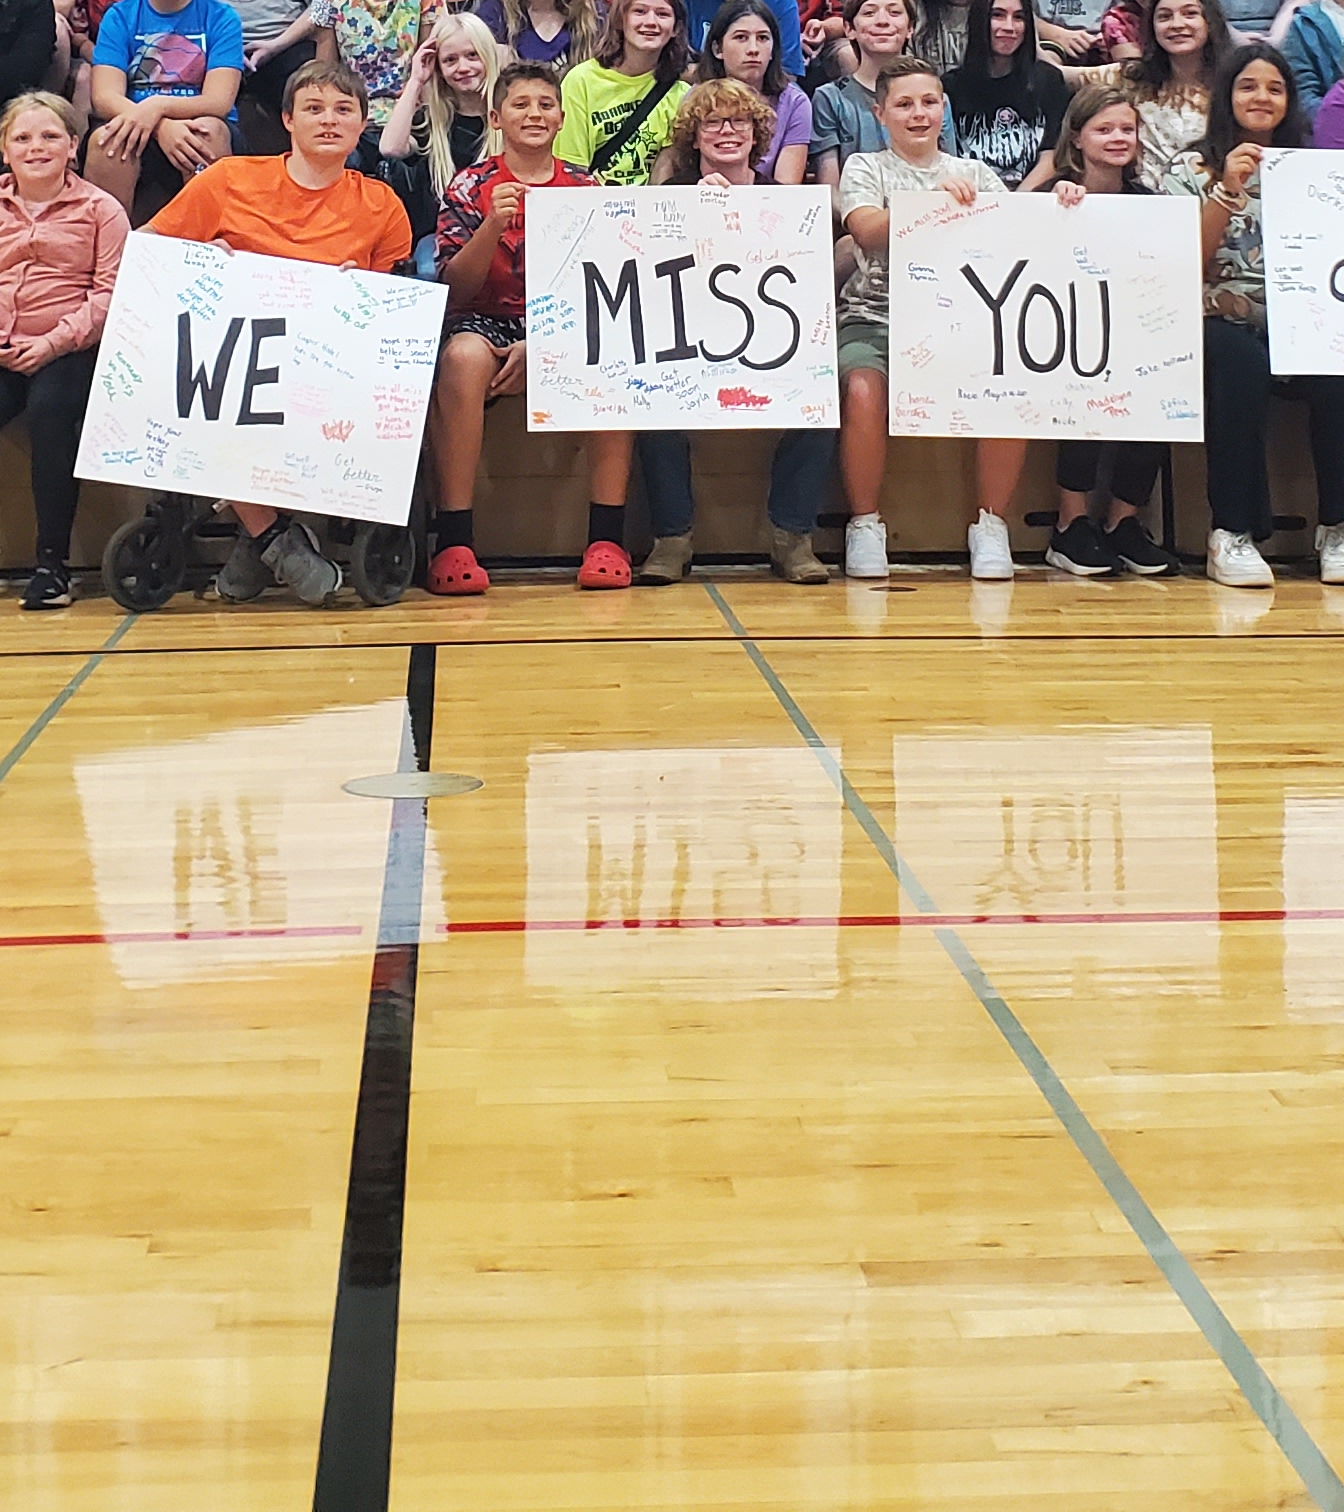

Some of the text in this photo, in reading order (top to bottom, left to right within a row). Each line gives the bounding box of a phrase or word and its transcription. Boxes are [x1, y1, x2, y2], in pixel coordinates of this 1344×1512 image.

[1050, 0, 1086, 15] THIS.
[177, 311, 287, 425] WE
[582, 254, 801, 370] MISS
